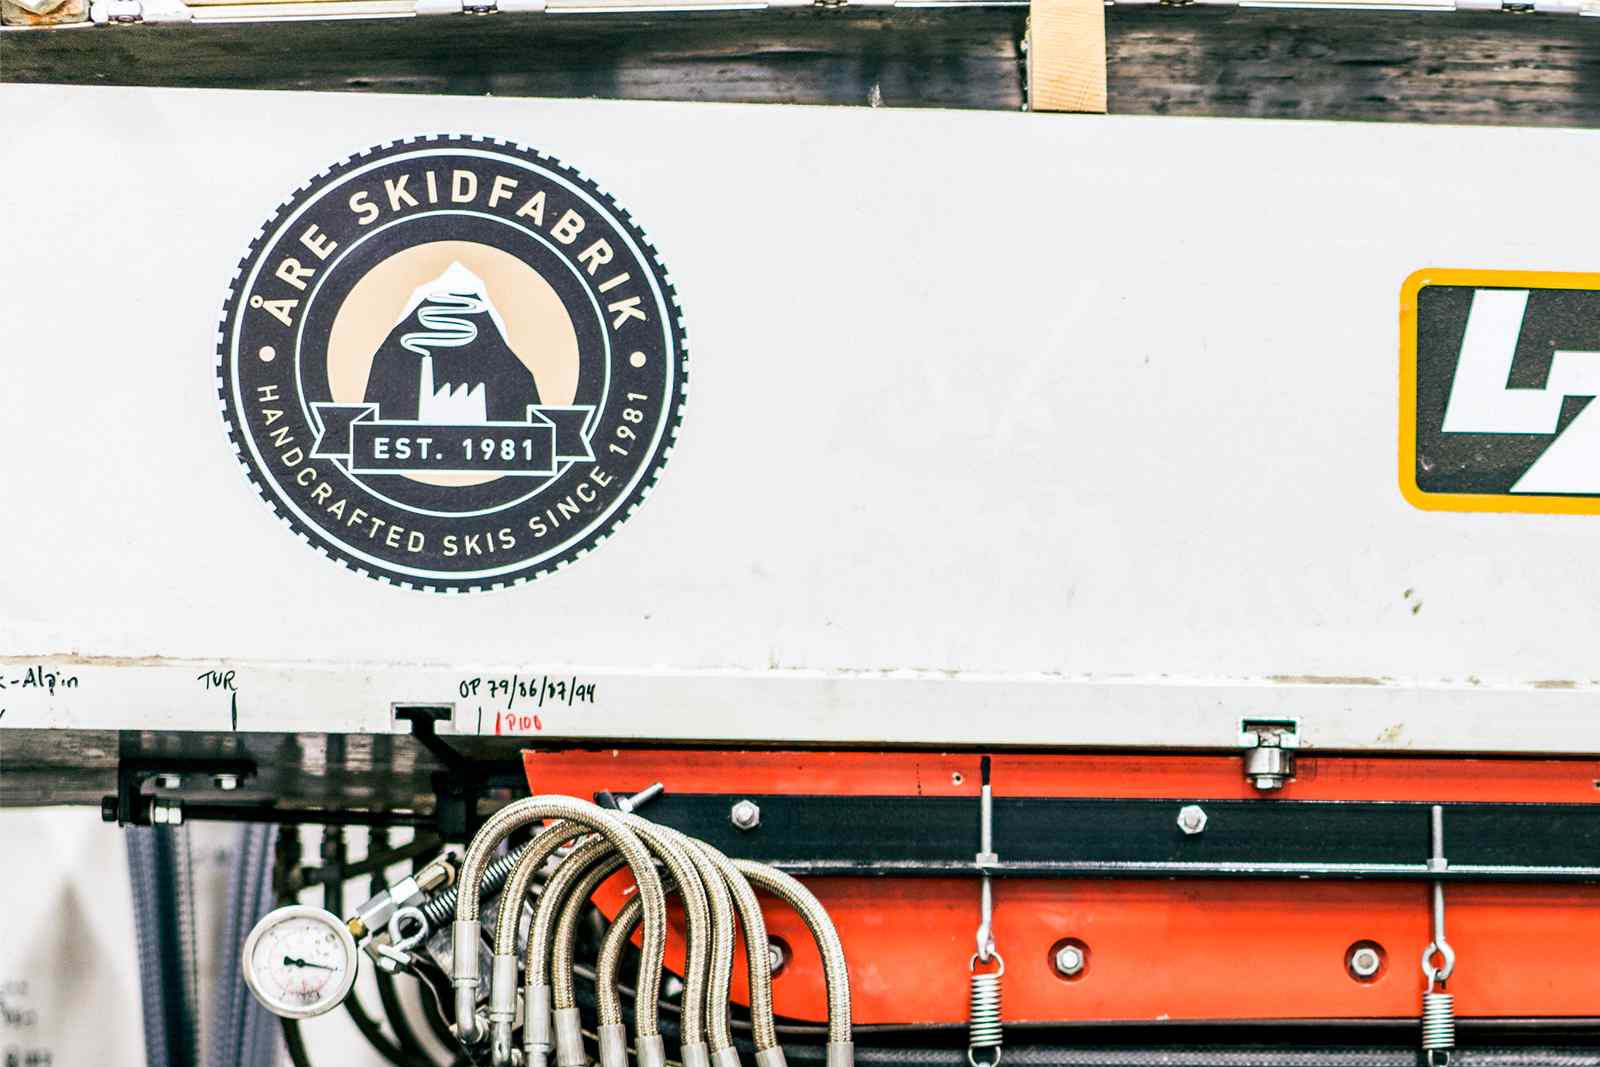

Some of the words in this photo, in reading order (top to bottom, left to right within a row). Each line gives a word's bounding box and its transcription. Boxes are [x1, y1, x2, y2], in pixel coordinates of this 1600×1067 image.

[250, 223, 339, 328] ÅRE
[348, 169, 648, 331] SKIDFABRIK
[256, 384, 426, 553] HANDCRAFTED
[442, 528, 517, 557] SKIS
[528, 465, 613, 539] SINCE
[609, 391, 648, 457] 1981
[373, 436, 443, 460] EST.
[462, 437, 534, 461] 1981
